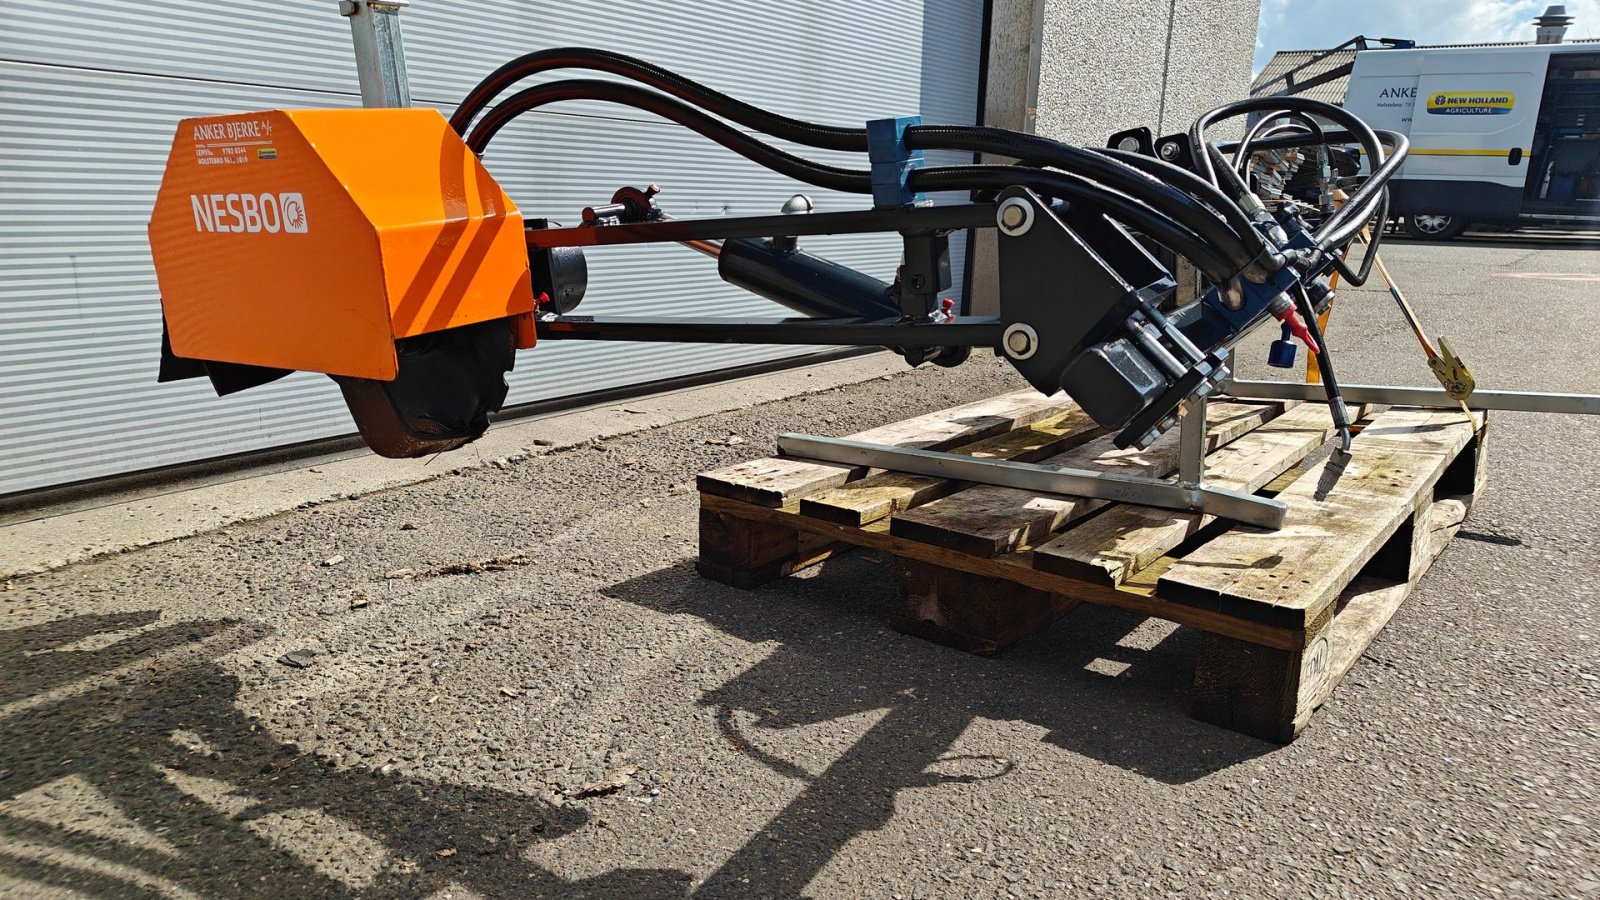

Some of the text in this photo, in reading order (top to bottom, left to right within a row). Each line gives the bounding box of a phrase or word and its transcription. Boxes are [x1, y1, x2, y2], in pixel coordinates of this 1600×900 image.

[193, 122, 227, 141] ANKER
[226, 120, 261, 141] BJERRE
[190, 192, 281, 234] NESBO
